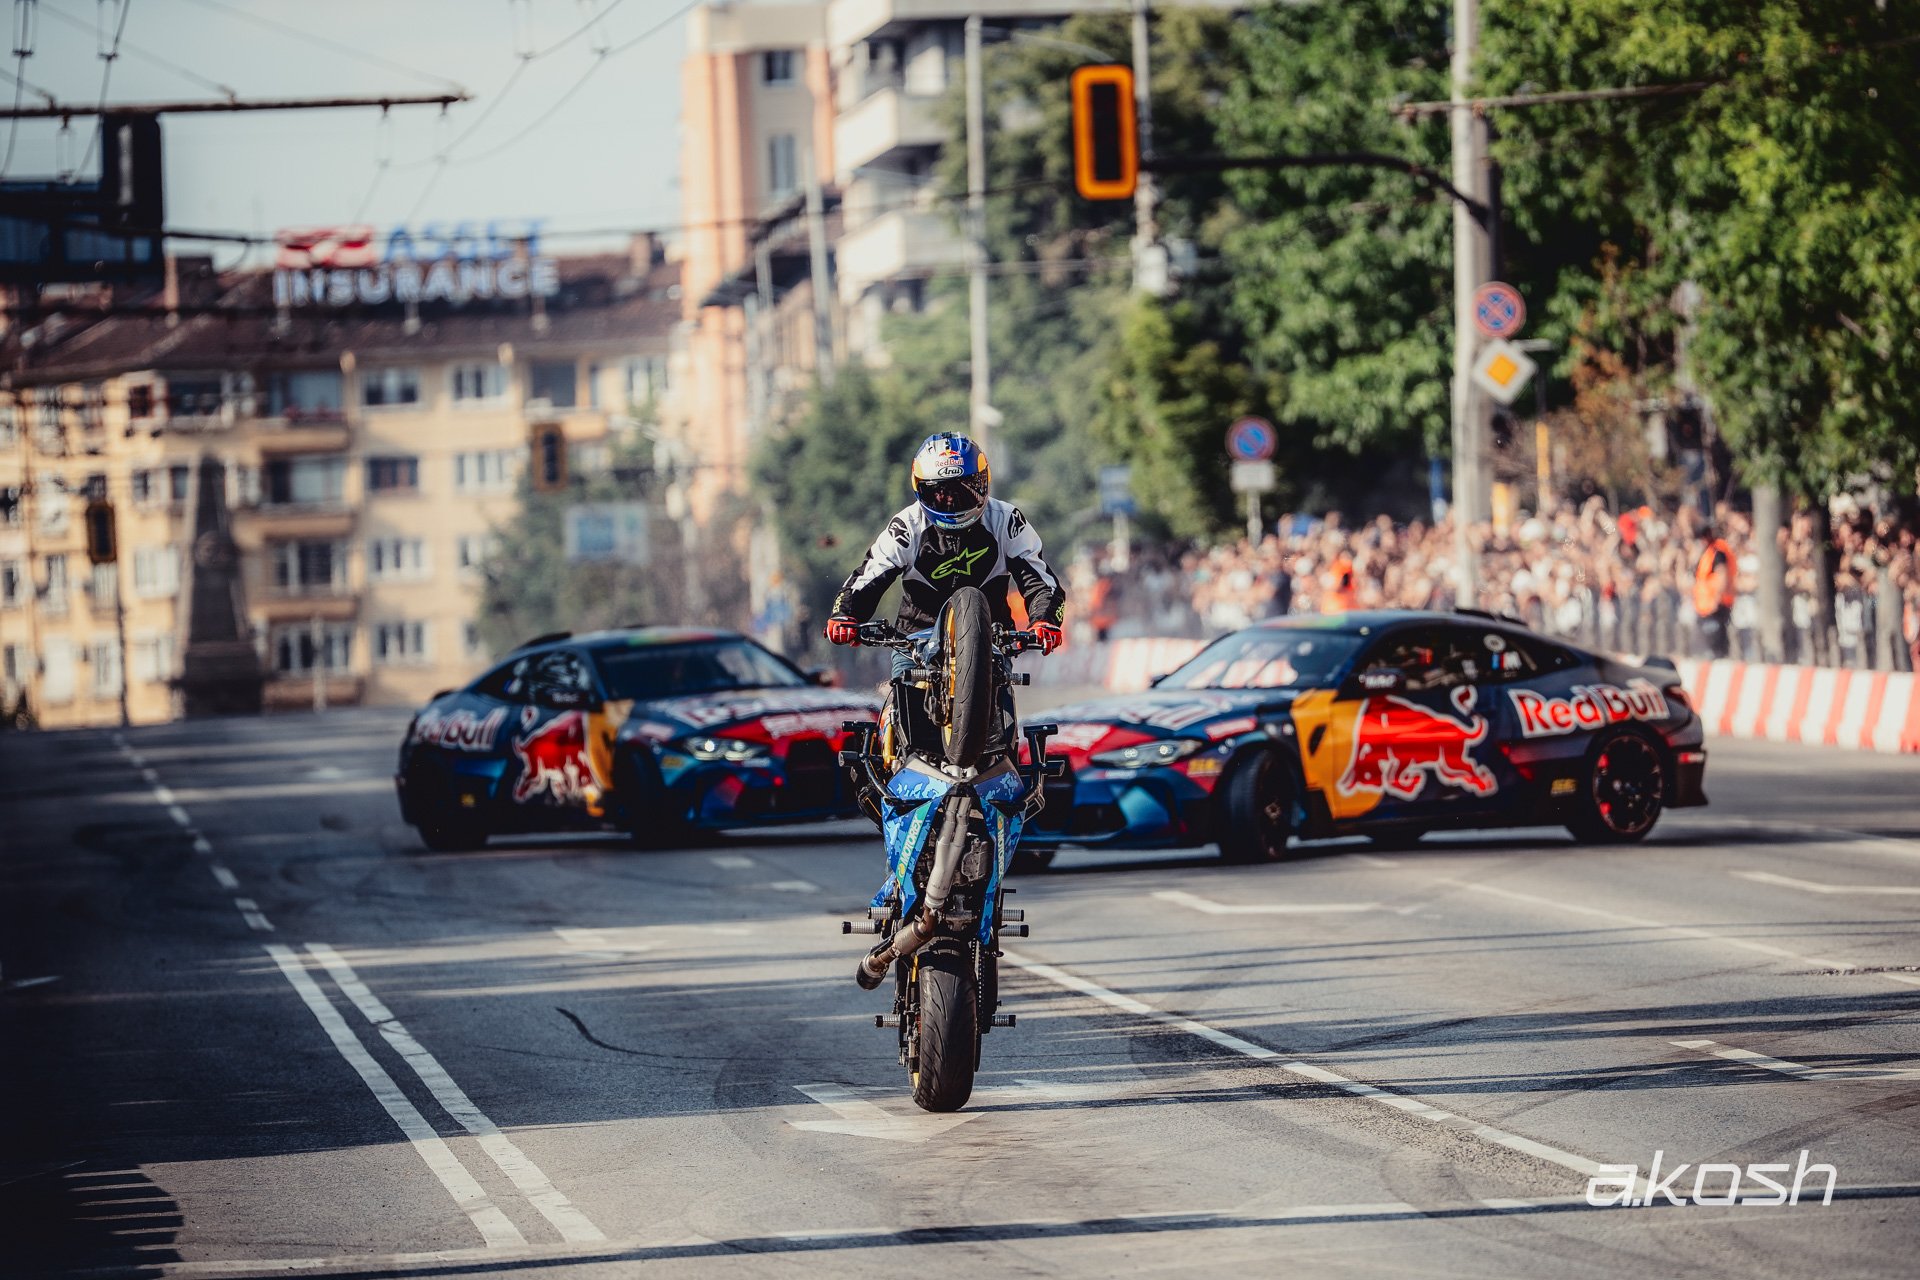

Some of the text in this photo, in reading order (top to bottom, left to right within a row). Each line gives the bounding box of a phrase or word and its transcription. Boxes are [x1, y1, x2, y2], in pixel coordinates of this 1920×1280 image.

[274, 259, 559, 305] INSURANCE
[935, 457, 964, 467] Red Bull
[943, 467, 961, 475] Arai
[1508, 678, 1670, 738] Red Bull
[900, 816, 923, 866] MOTOREX
